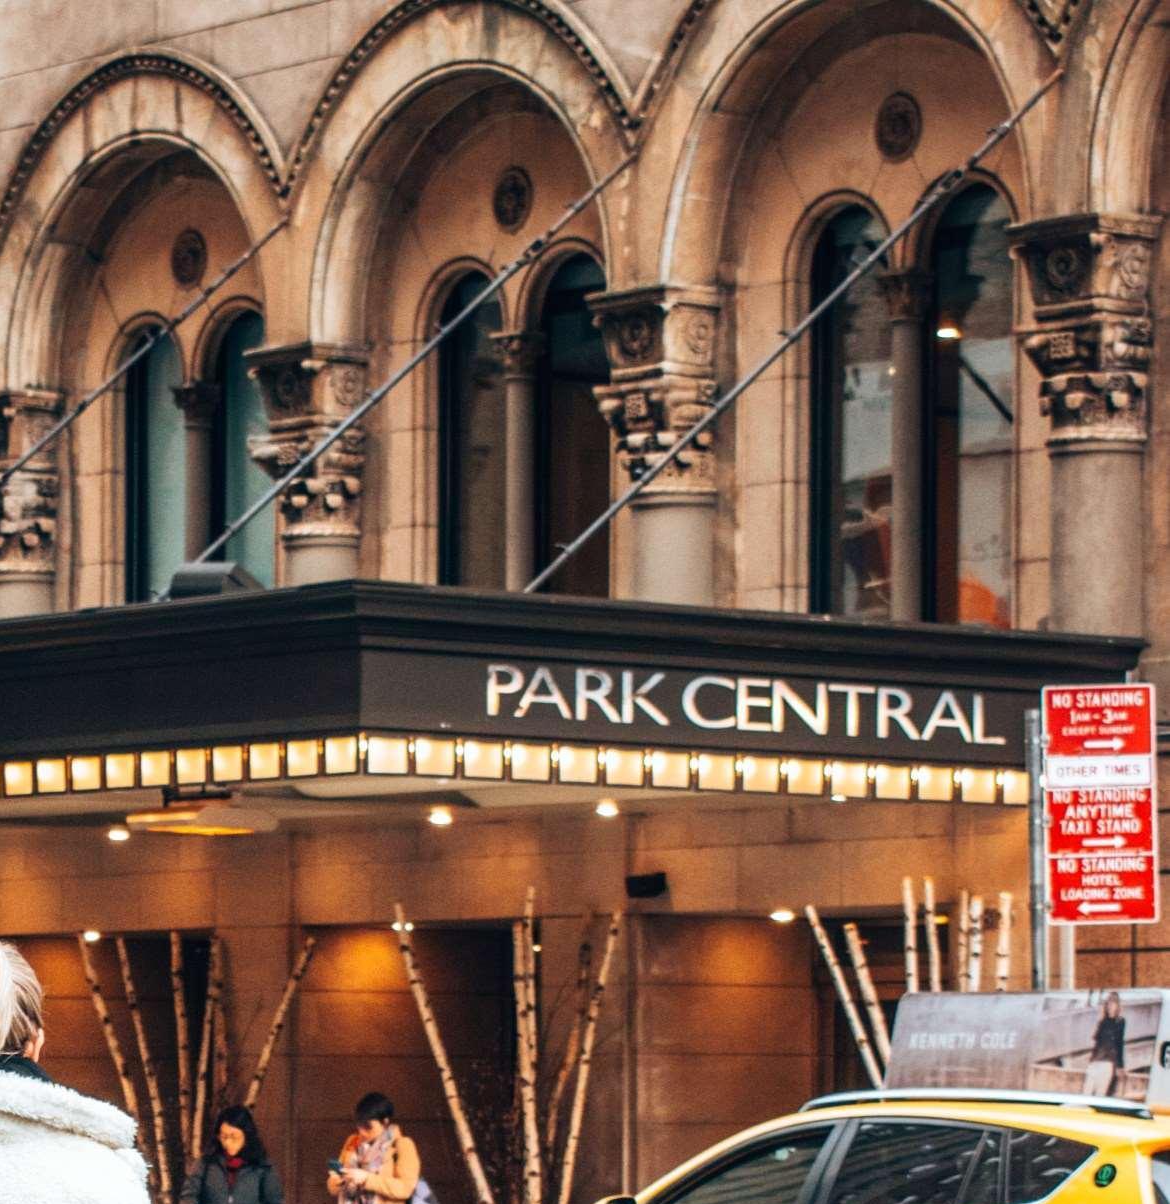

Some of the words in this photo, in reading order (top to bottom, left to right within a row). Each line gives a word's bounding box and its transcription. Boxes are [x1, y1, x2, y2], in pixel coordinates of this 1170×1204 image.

[486, 663, 669, 726] PARK
[681, 675, 1007, 745] CENTRAL
[1051, 692, 1072, 709] NO
[1076, 689, 1145, 708] STANDING
[1056, 765, 1097, 779] OTHER
[1104, 763, 1142, 777] TIMES
[1052, 789, 1073, 805] NO
[1078, 788, 1148, 805] STANDING
[1065, 804, 1135, 820] ANYTIME
[1060, 820, 1091, 835] TAXI
[1096, 819, 1142, 834] STAND
[1057, 857, 1078, 874] NO
[1081, 856, 1148, 873] STANDING
[1081, 873, 1122, 887] HOTEL
[1060, 888, 1111, 901] LOADING
[1112, 887, 1145, 900] ZONE
[909, 1031, 976, 1049] KENNETH
[980, 1031, 1017, 1049] COLE
